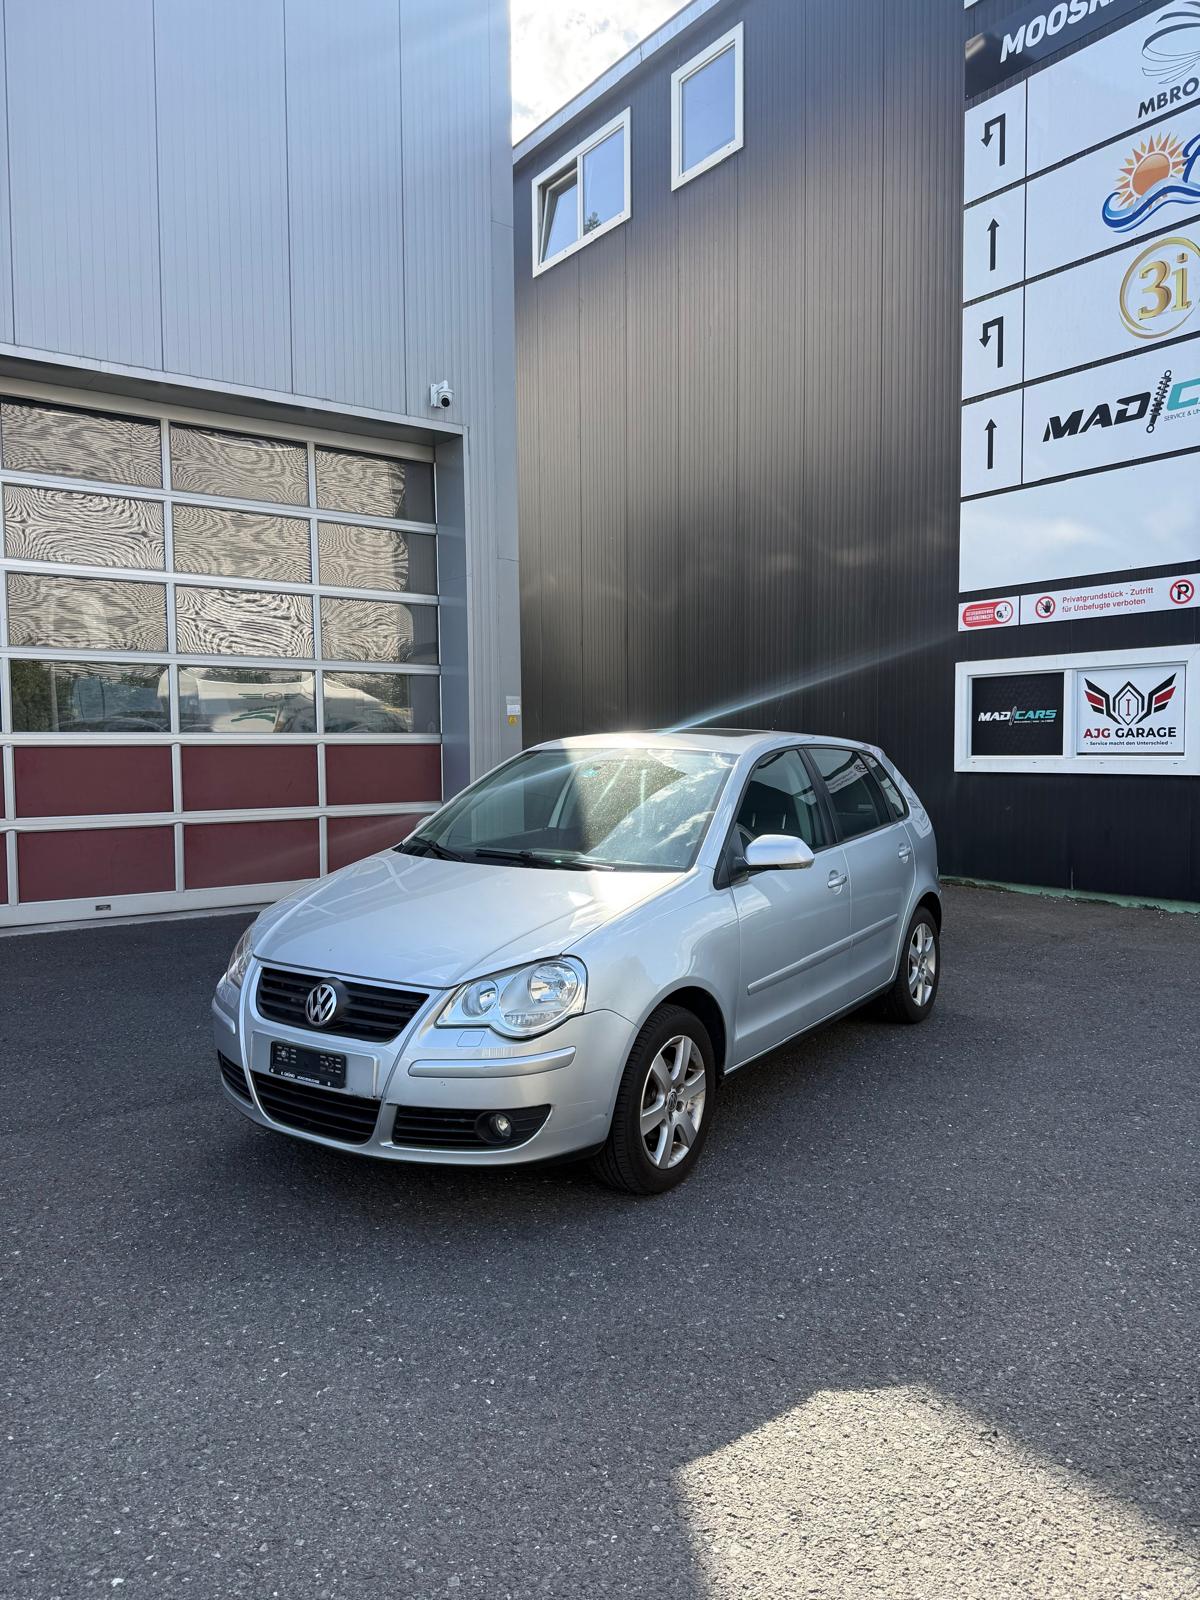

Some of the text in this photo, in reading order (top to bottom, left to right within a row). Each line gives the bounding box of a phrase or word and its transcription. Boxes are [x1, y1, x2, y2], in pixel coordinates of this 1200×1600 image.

[1000, 0, 1115, 63] MOOS
[1137, 77, 1200, 119] MBRO
[1138, 252, 1192, 320] 3i
[1042, 378, 1200, 442] MAD C
[1062, 591, 1124, 604] Privatgrundstück
[1130, 586, 1154, 596] Zutritt
[1062, 598, 1146, 613] für Unbefugte verboten
[978, 711, 1012, 722] MAD
[1014, 709, 1058, 720] CARS
[1083, 726, 1177, 739] AJG GARAGE
